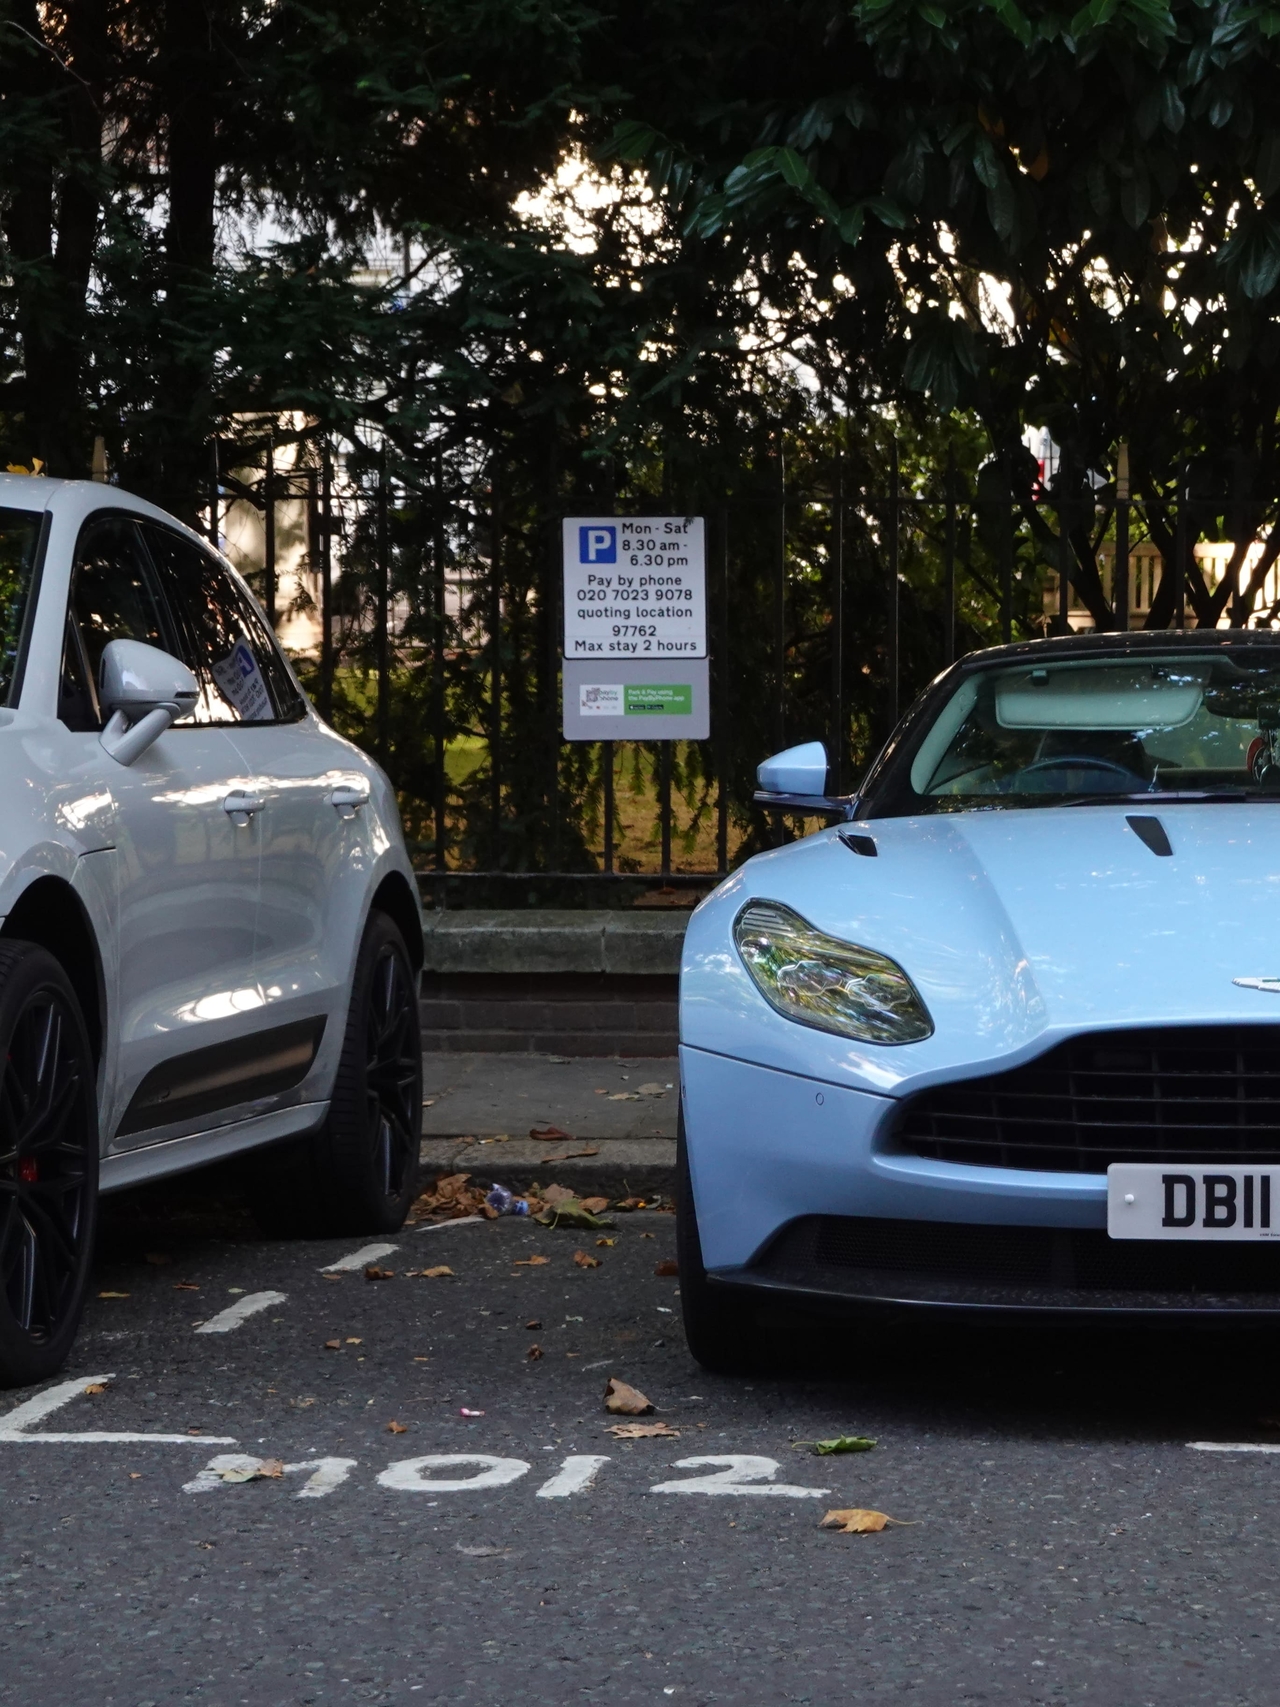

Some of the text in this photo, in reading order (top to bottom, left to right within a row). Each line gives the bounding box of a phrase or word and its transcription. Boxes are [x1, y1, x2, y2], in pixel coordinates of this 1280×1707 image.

[622, 523, 651, 534] Mon
[663, 522, 688, 534] Sat
[588, 530, 612, 561] P
[622, 539, 656, 551] 8.30
[659, 542, 680, 551] am
[630, 554, 688, 567] 6.30 pm
[588, 574, 682, 588] Pay by phone
[577, 589, 693, 601] 020 7023 9078
[577, 606, 693, 619] quoting location
[612, 625, 657, 636] 97762
[575, 640, 697, 653] Max stay 2 hours
[1162, 1174, 1271, 1228] DB11
